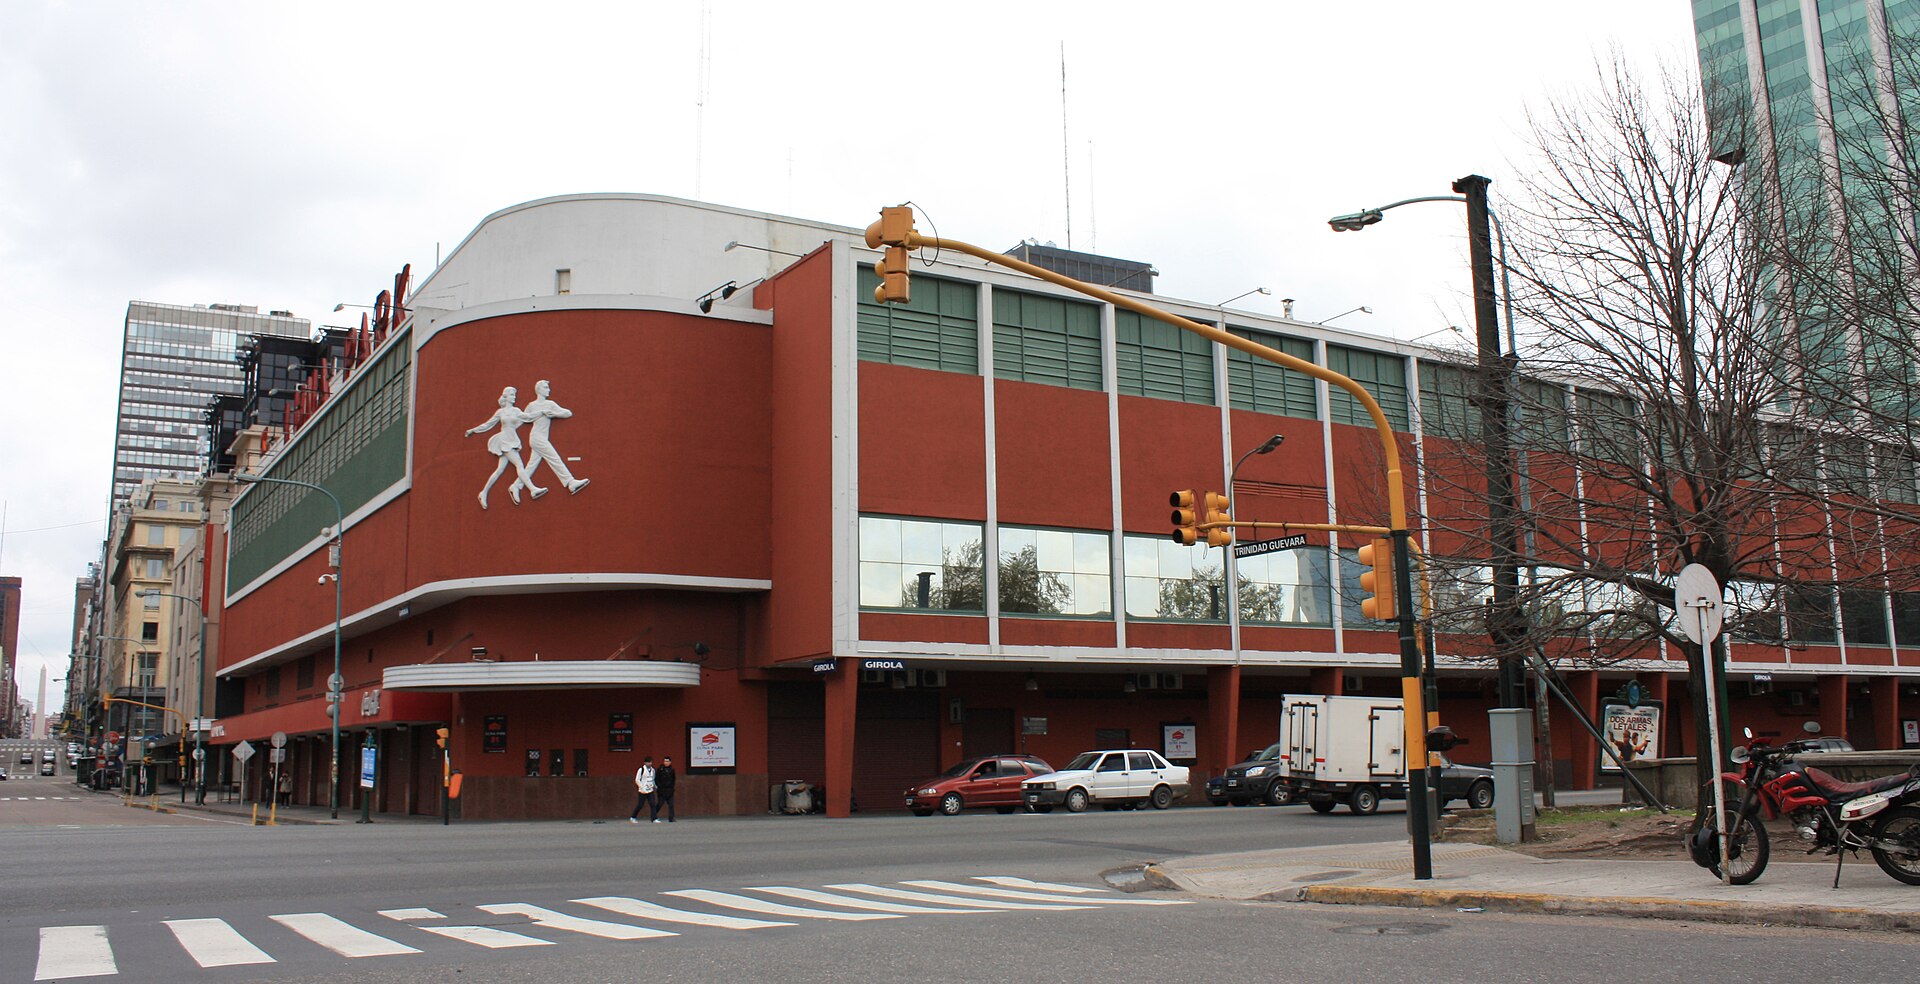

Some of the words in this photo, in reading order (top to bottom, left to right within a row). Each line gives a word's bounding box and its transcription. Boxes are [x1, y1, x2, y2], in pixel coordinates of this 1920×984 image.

[1235, 544, 1268, 556] TRINIDAD
[1269, 536, 1306, 550] GUEVARA
[813, 663, 835, 672] GIROLA
[865, 661, 904, 669] GIROLA
[1610, 715, 1625, 724] DOS
[1626, 716, 1652, 725] ARMAS
[1613, 723, 1648, 731] LETALES
